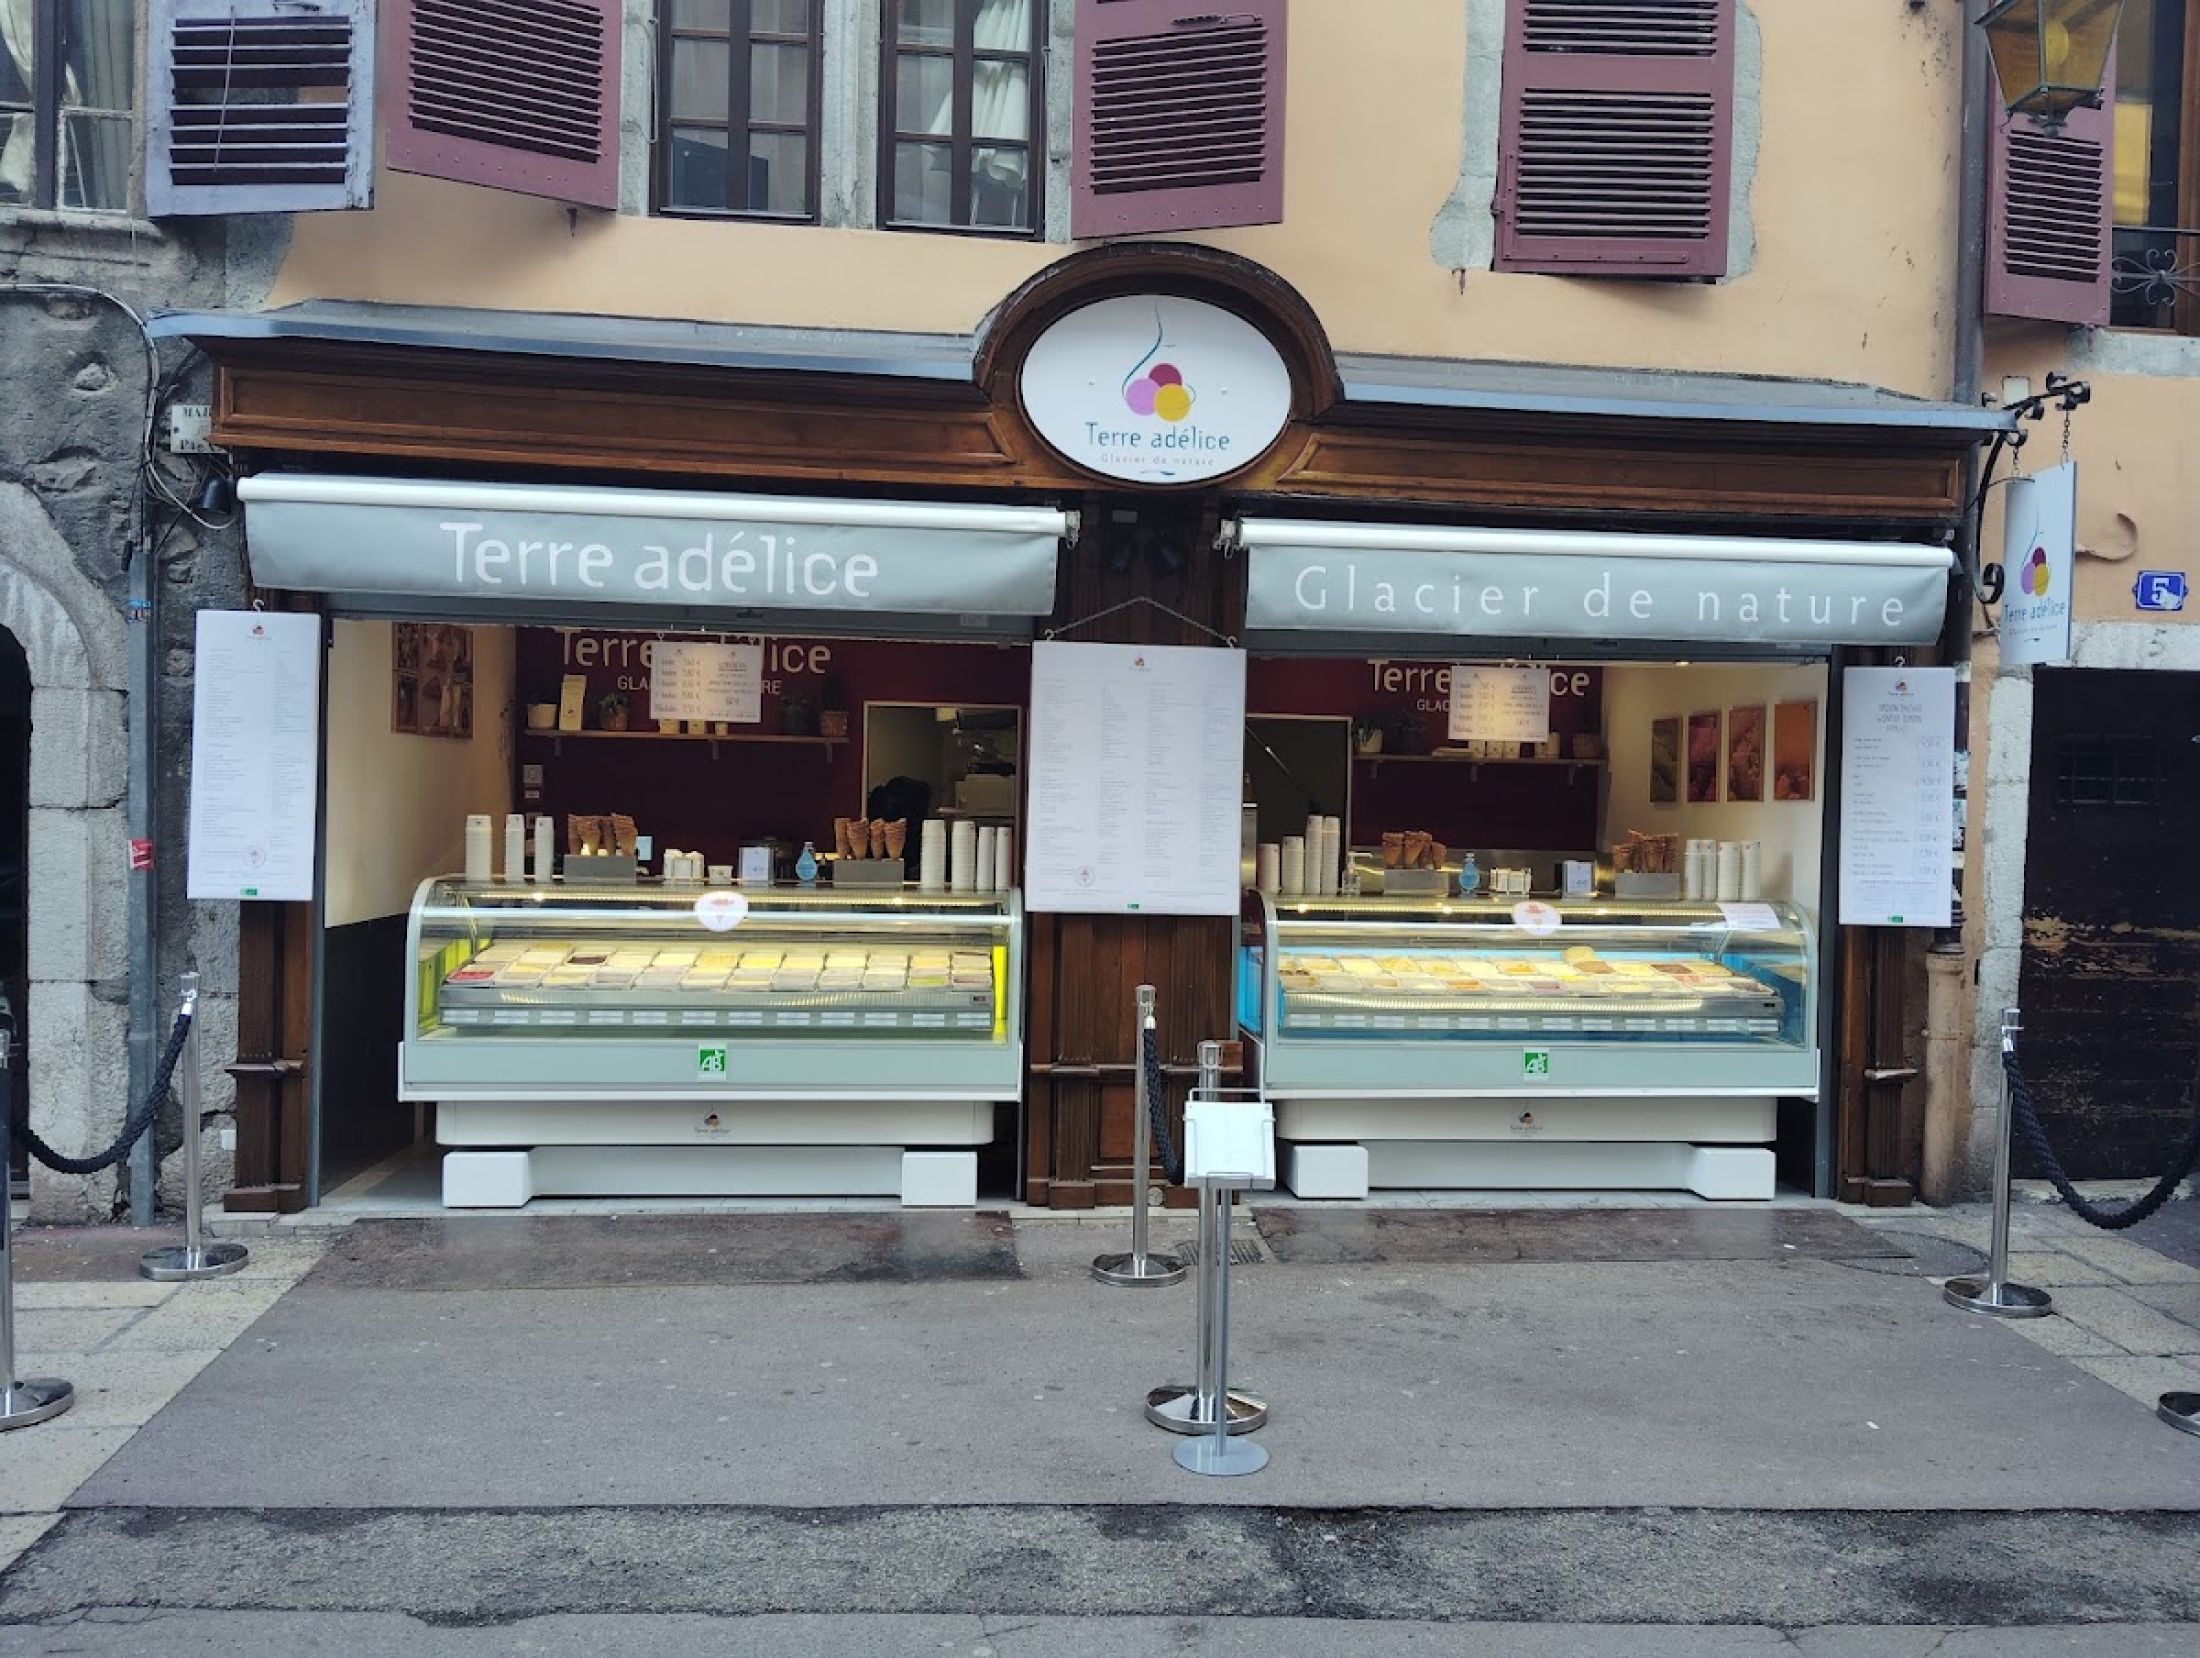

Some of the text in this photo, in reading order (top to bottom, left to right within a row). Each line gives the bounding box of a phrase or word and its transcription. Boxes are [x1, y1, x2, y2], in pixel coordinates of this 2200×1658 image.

[1085, 421, 1230, 450] Terre adélice
[1101, 453, 1145, 464] Glacier
[1152, 455, 1167, 464] de
[439, 522, 879, 597] Terre adélice
[1295, 564, 1904, 626] Glacier de nature
[1416, 698, 1450, 713] GLAC
